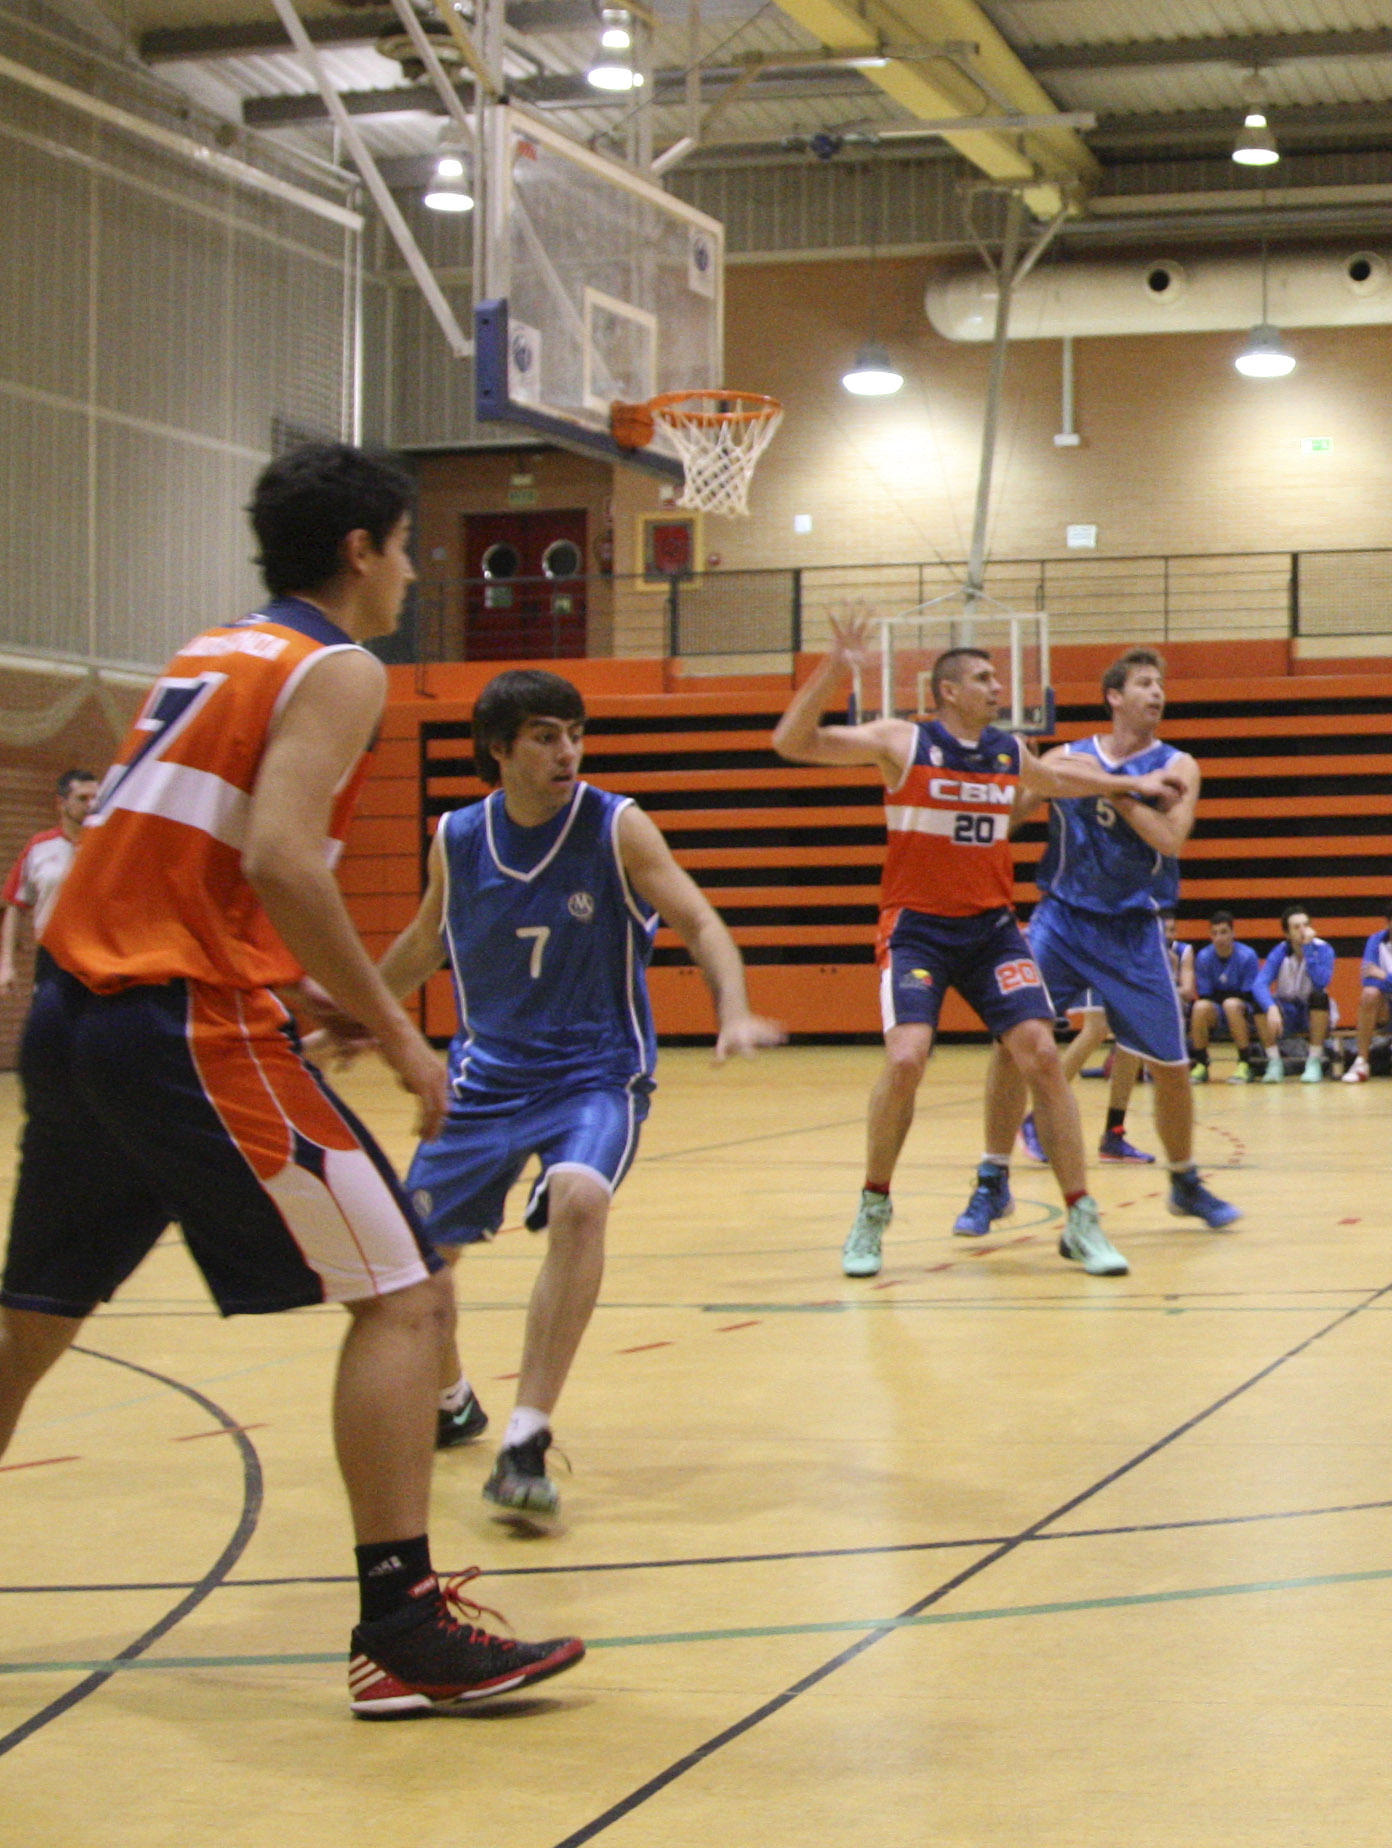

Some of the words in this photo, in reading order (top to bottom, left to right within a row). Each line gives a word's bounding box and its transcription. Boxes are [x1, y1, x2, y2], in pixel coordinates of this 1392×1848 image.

[83, 671, 229, 826] 7
[928, 777, 1015, 805] CBM
[953, 812, 995, 847] 20
[515, 926, 550, 979] 7
[995, 959, 1041, 995] 20
